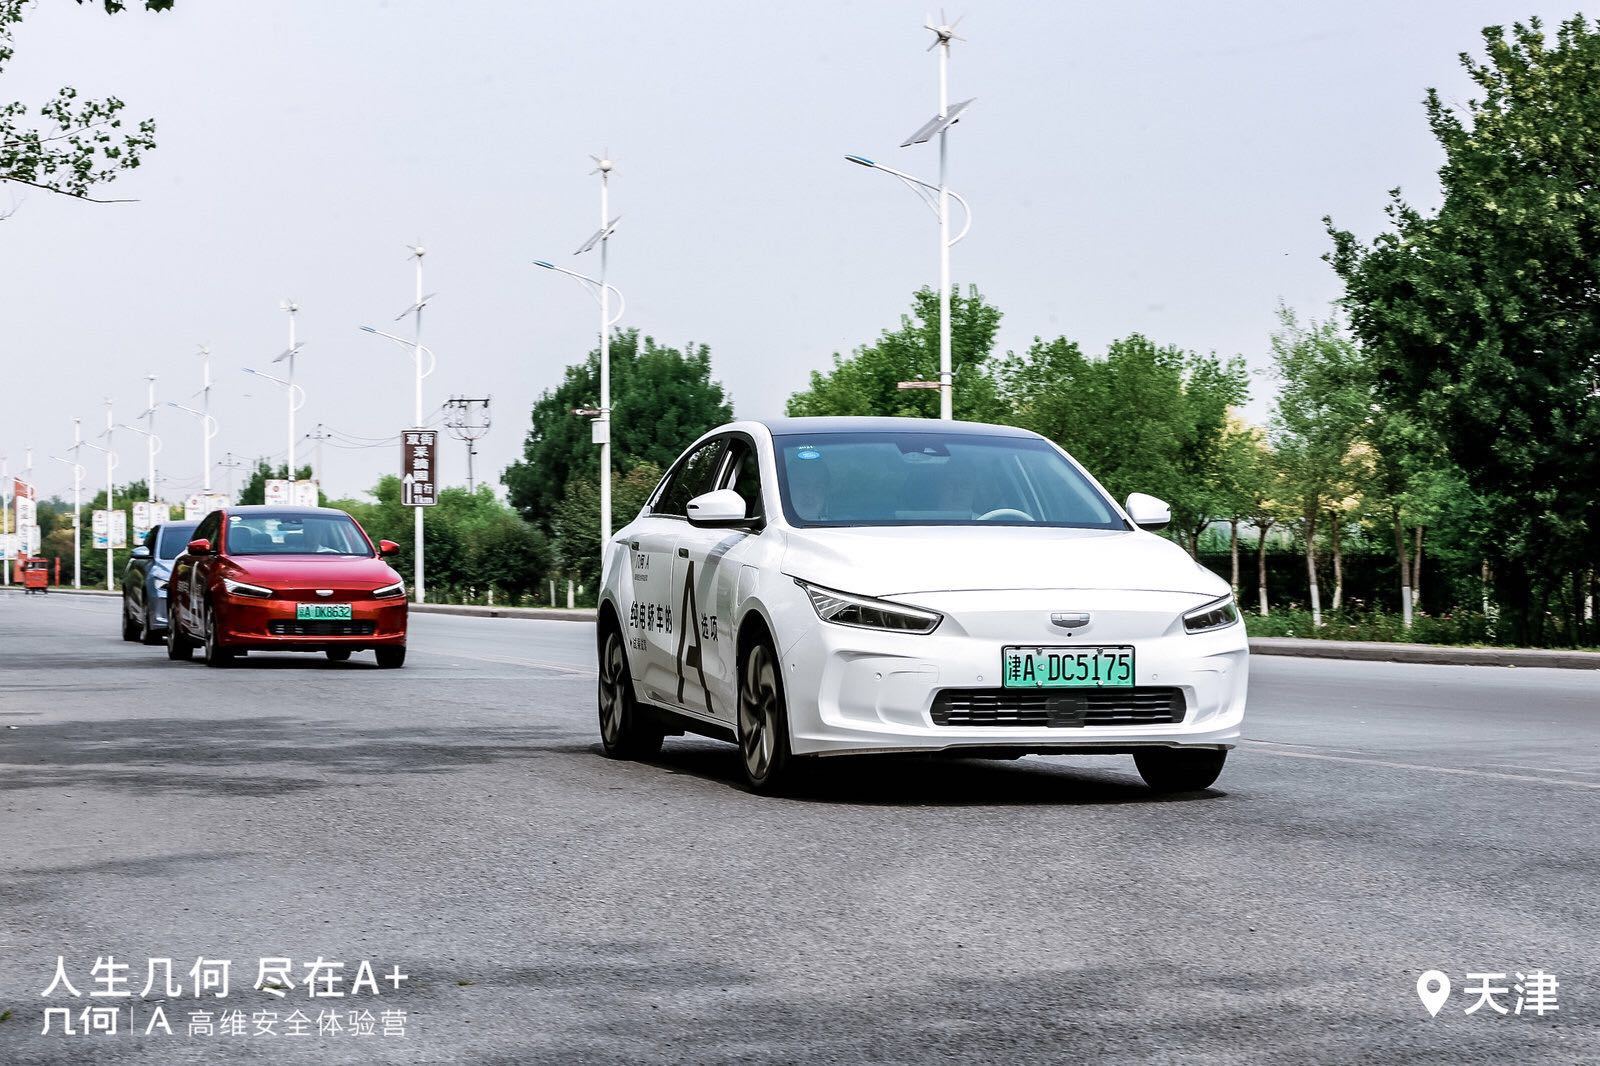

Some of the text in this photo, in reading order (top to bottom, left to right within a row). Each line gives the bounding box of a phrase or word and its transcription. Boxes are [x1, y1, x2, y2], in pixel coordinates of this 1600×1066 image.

[629, 560, 719, 714] 纯电轿车的 A 选项
